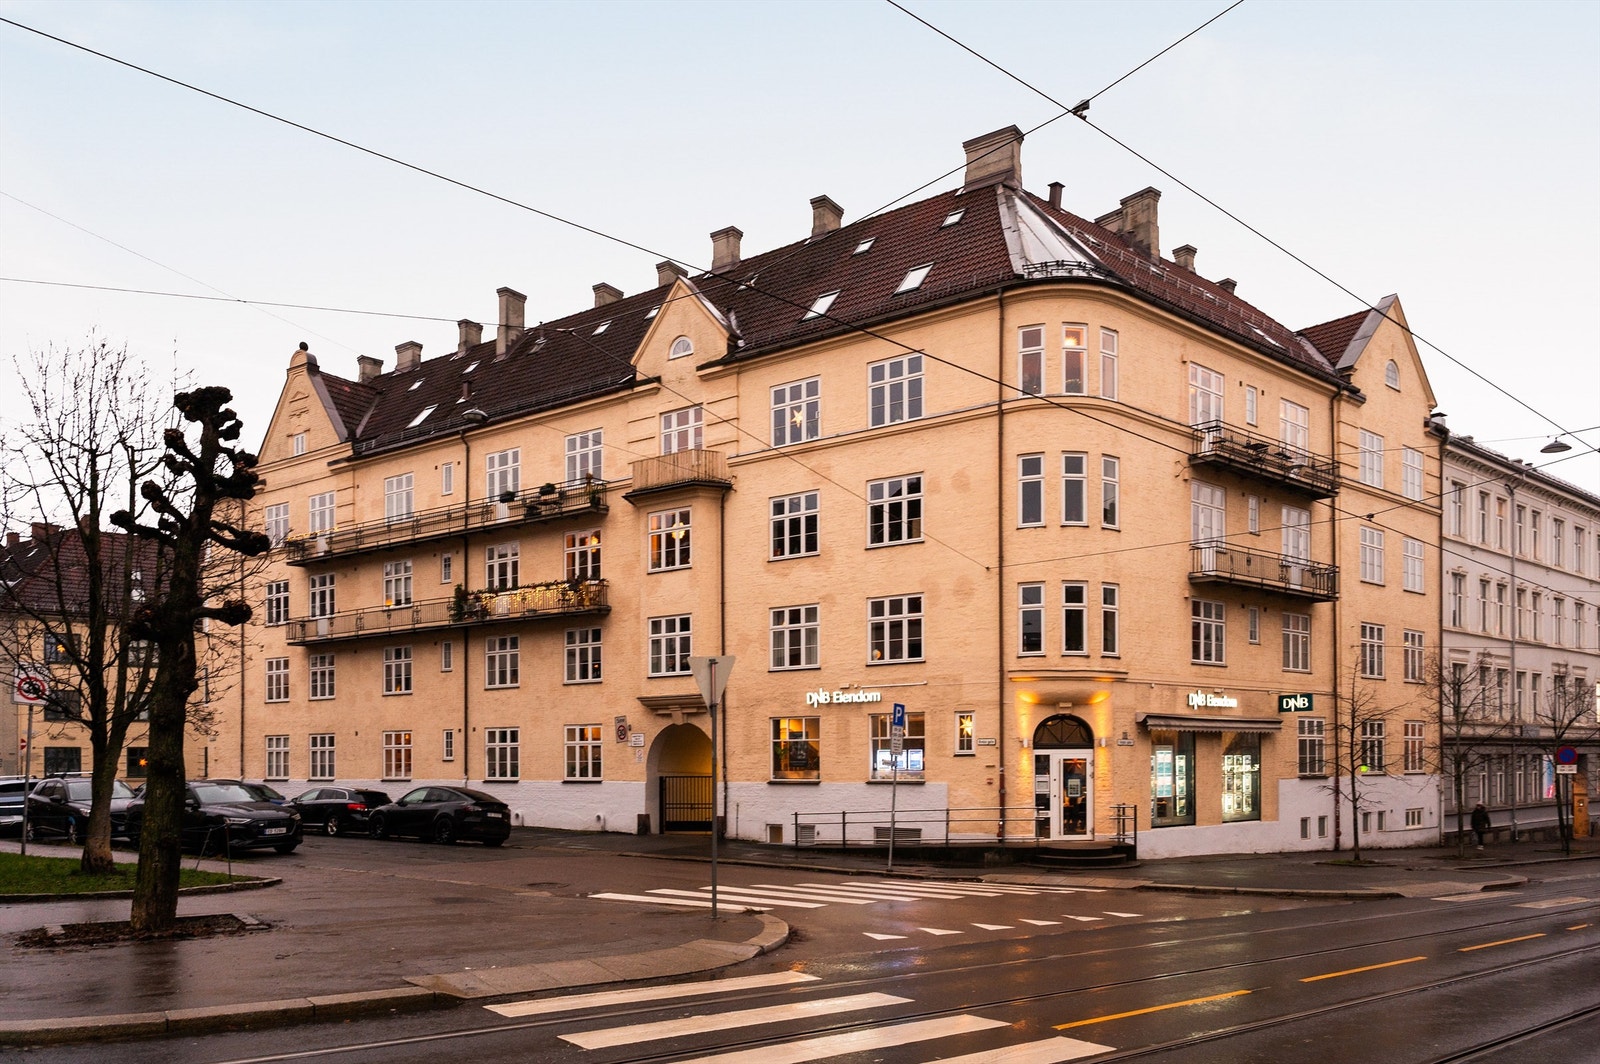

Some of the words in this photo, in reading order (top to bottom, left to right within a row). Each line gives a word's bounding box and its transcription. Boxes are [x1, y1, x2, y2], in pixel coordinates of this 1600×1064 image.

[806, 687, 830, 708] DNB
[833, 690, 881, 703] Eiendom
[1188, 689, 1206, 710] DNB
[1206, 694, 1238, 708] Eiendom
[1283, 693, 1309, 712] DNB
[895, 706, 903, 723] P
[618, 729, 625, 737] 30
